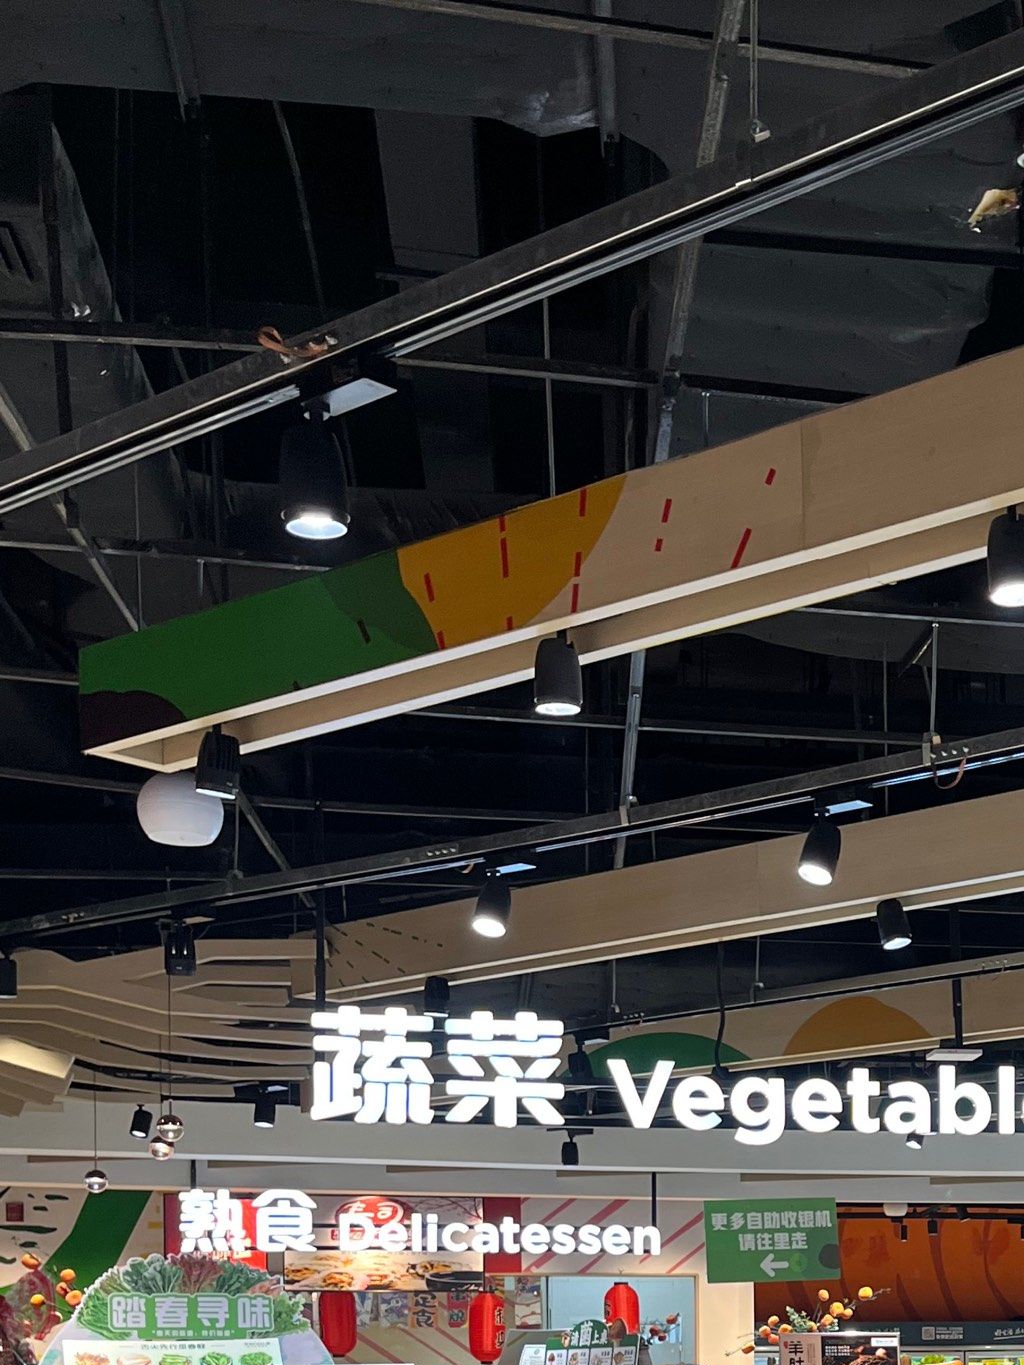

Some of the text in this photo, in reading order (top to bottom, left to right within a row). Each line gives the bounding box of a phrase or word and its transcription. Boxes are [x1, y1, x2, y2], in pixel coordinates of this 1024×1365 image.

[309, 1005, 566, 1129] 蔬菜
[178, 1188, 318, 1253] 熟食
[338, 1211, 662, 1255] Delicatessen
[711, 1210, 833, 1231] 更多自助收银机
[738, 1232, 808, 1251] 请往里走
[111, 1296, 271, 1329] 踏春寻味
